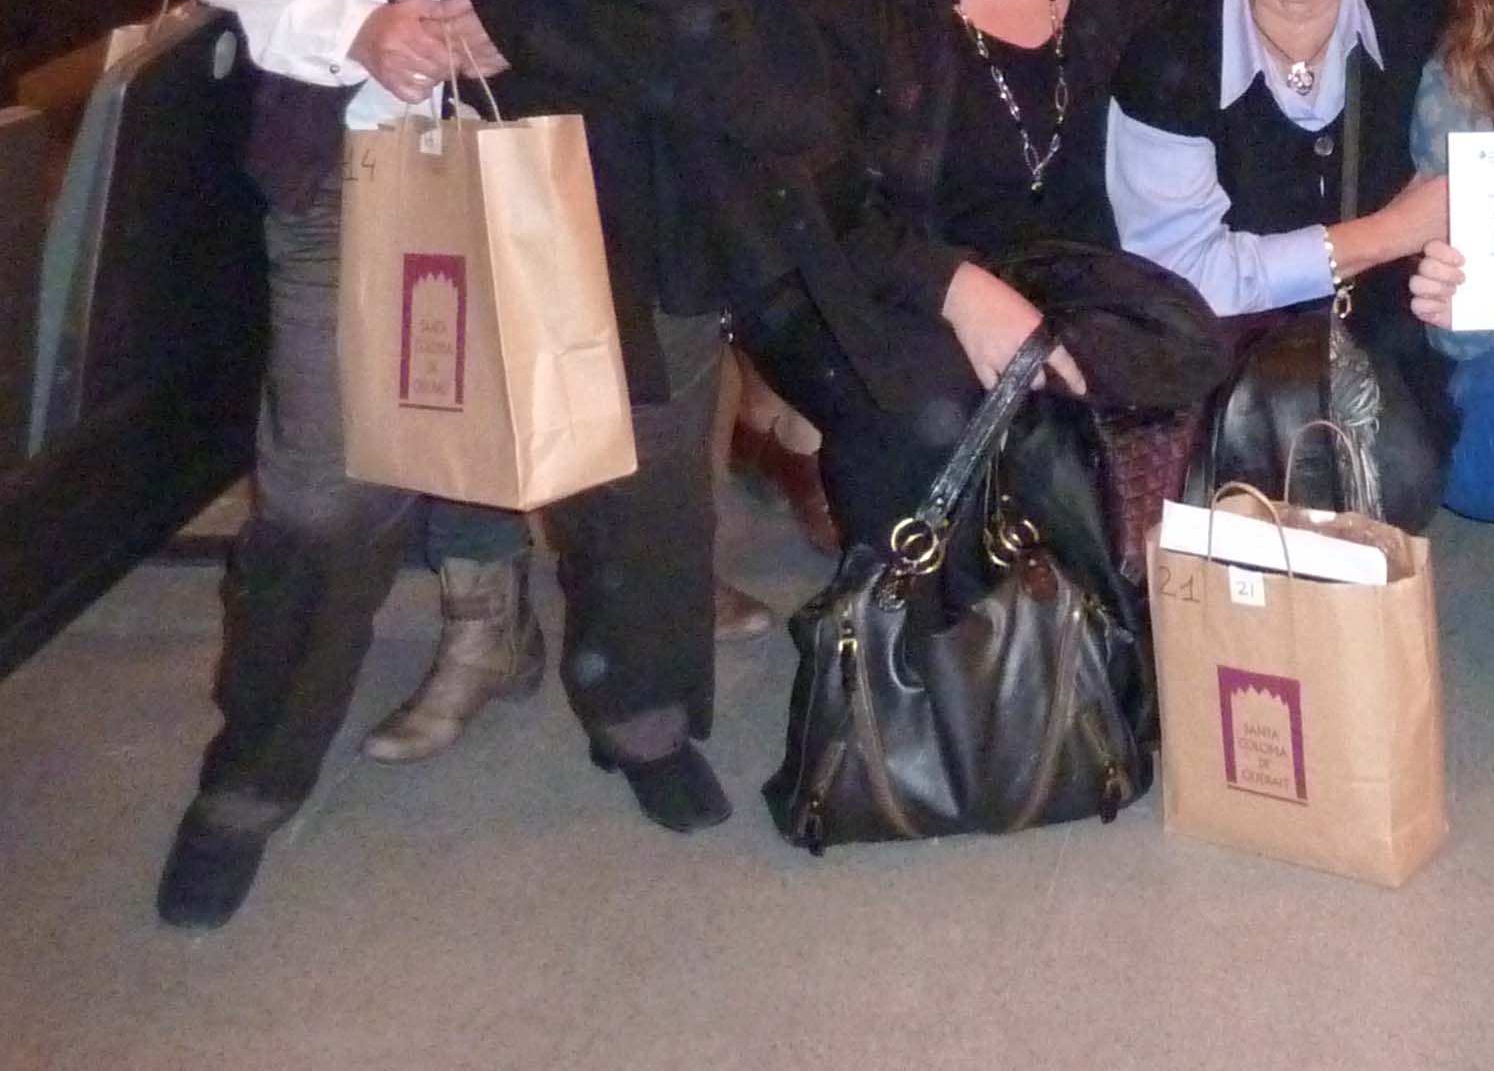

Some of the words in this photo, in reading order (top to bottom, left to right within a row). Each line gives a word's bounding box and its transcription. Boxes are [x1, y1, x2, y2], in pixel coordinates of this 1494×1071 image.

[1158, 566, 1200, 603] 21
[1237, 581, 1255, 599] 21
[1243, 722, 1280, 740] SANTA
